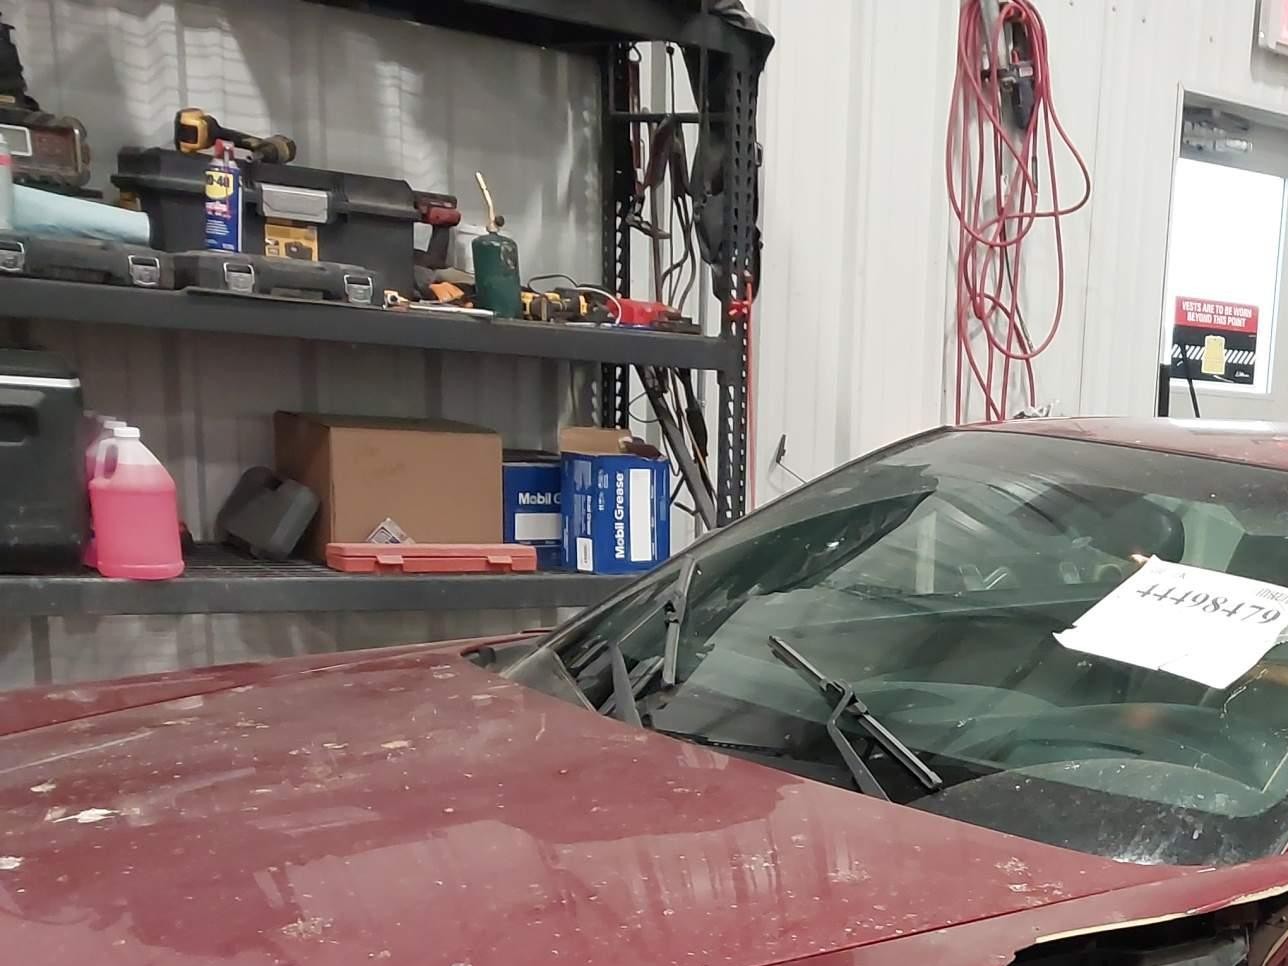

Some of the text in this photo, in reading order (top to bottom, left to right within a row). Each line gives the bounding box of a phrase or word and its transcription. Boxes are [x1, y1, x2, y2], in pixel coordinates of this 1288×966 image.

[1182, 301, 1252, 318] VESTS ARE TO BE WORN
[1187, 311, 1247, 327] BEYOND THIS POINT
[519, 492, 552, 505] Mobil
[614, 472, 625, 559] Mobil Grease
[1136, 583, 1281, 624] 44498479
